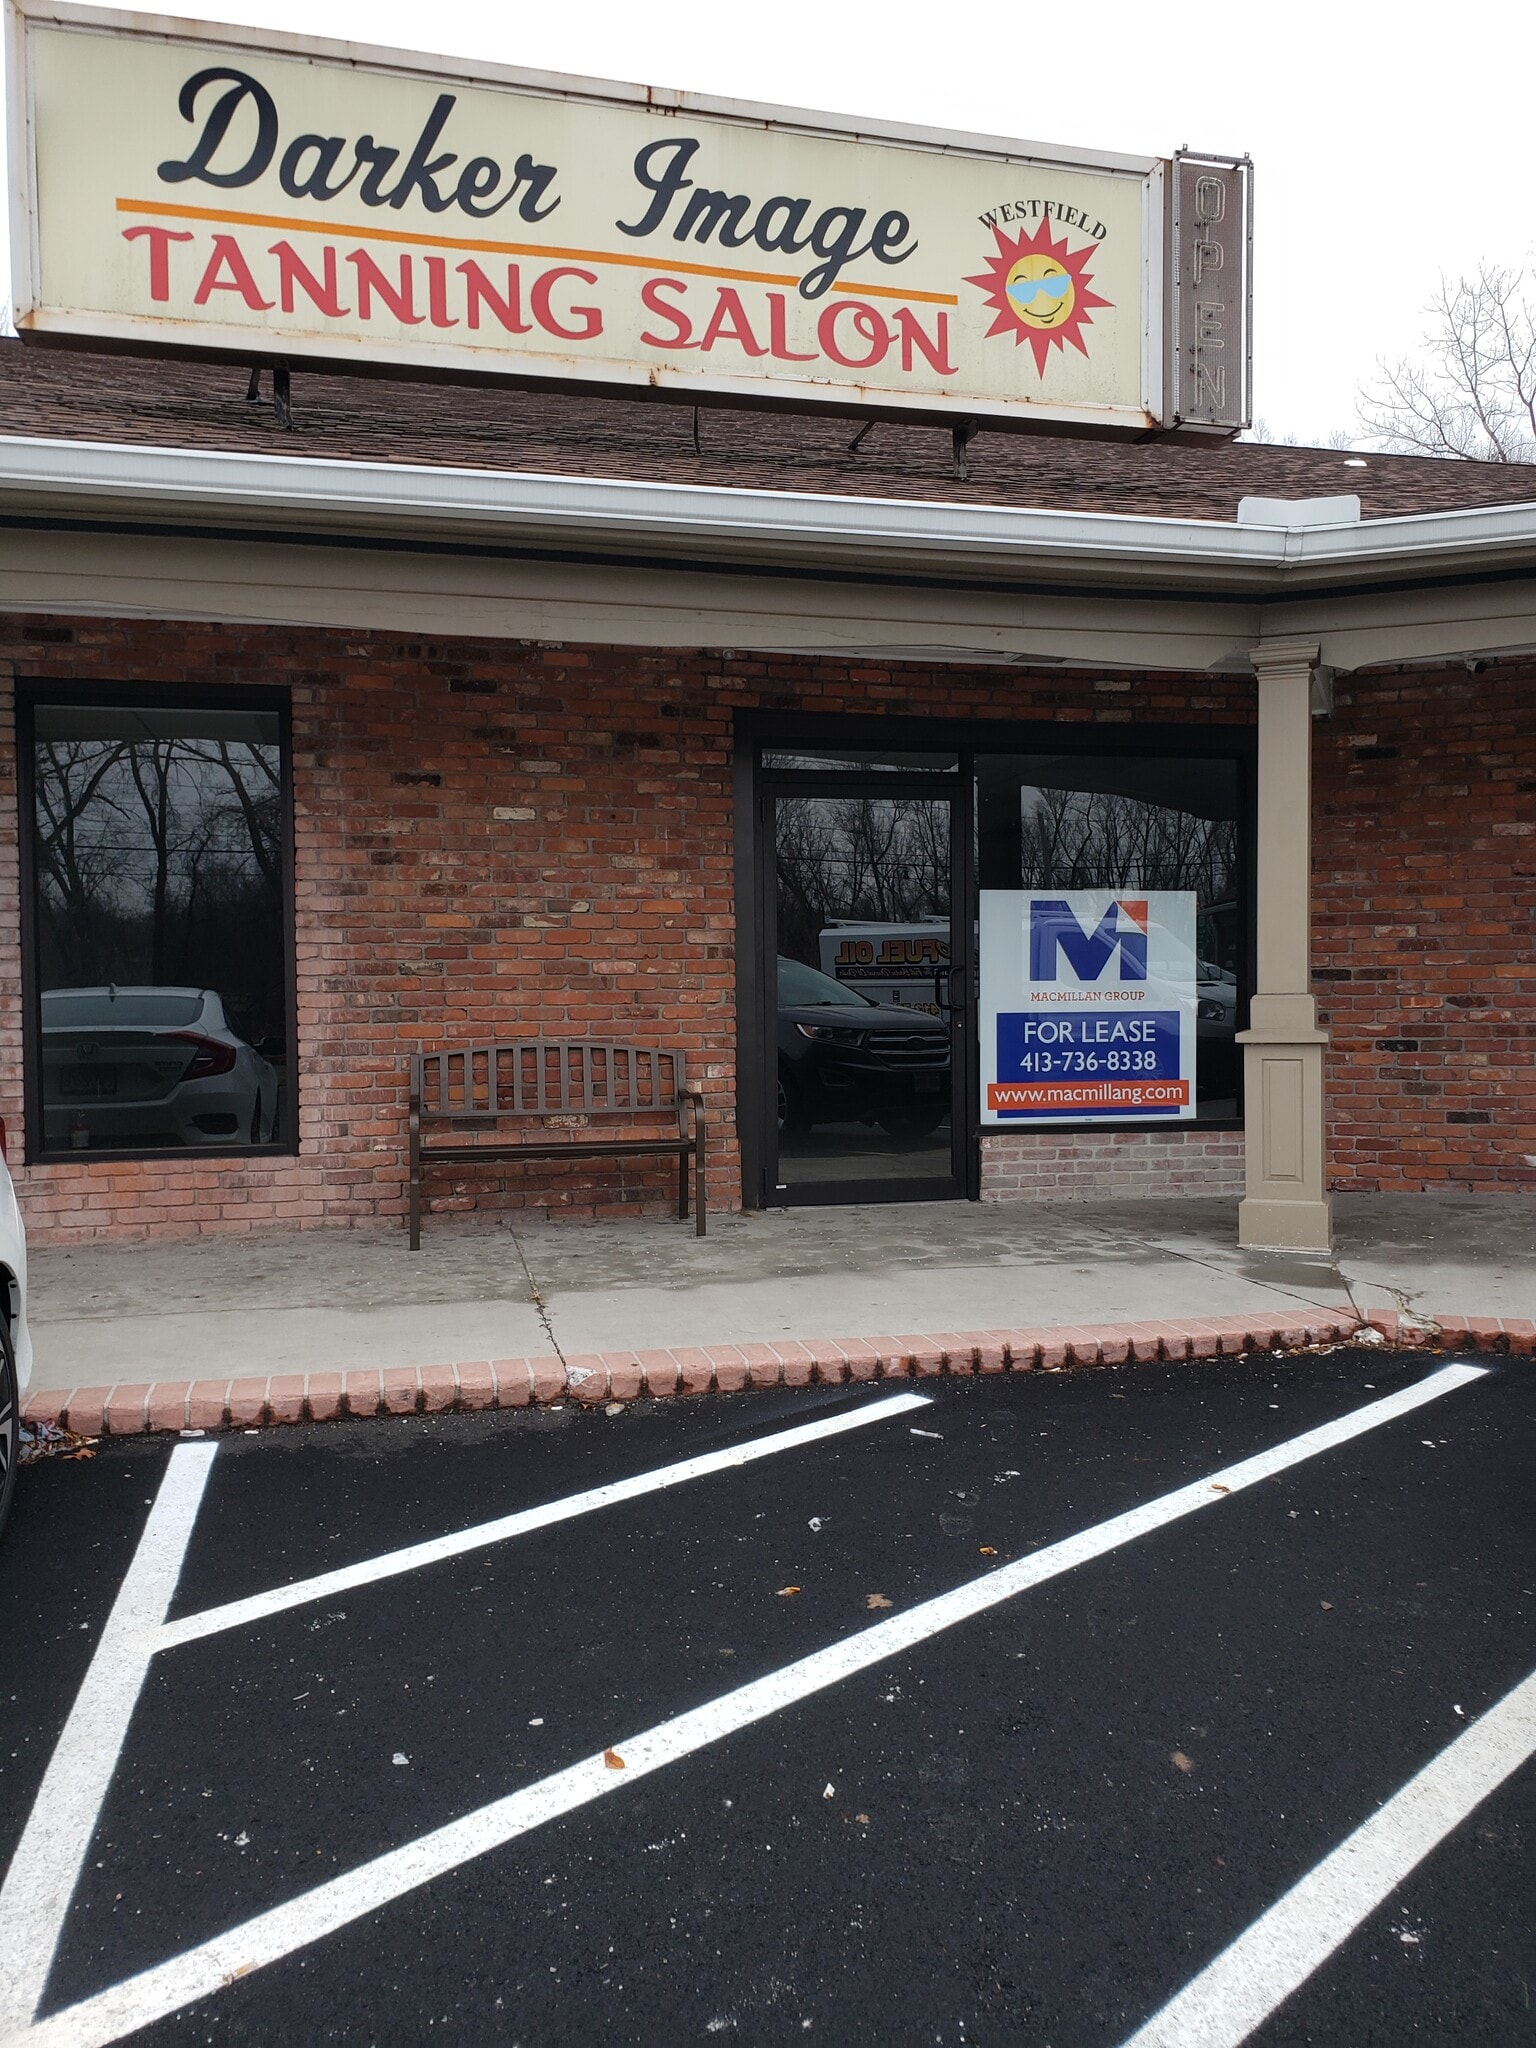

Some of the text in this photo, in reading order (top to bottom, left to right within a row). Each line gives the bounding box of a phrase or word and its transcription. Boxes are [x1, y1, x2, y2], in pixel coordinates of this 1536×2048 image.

[157, 67, 919, 300] Darker Image
[977, 199, 1107, 241] WESTFIELD
[121, 226, 959, 376] TANNING SALON
[1194, 175, 1226, 409] OPEN
[1030, 991, 1145, 1002] MACMILLAN GROUP
[1024, 1020, 1156, 1044] FOR LEASE
[1019, 1050, 1157, 1072] 413-736-8338
[994, 1083, 1183, 1105] www.macmillang.com
